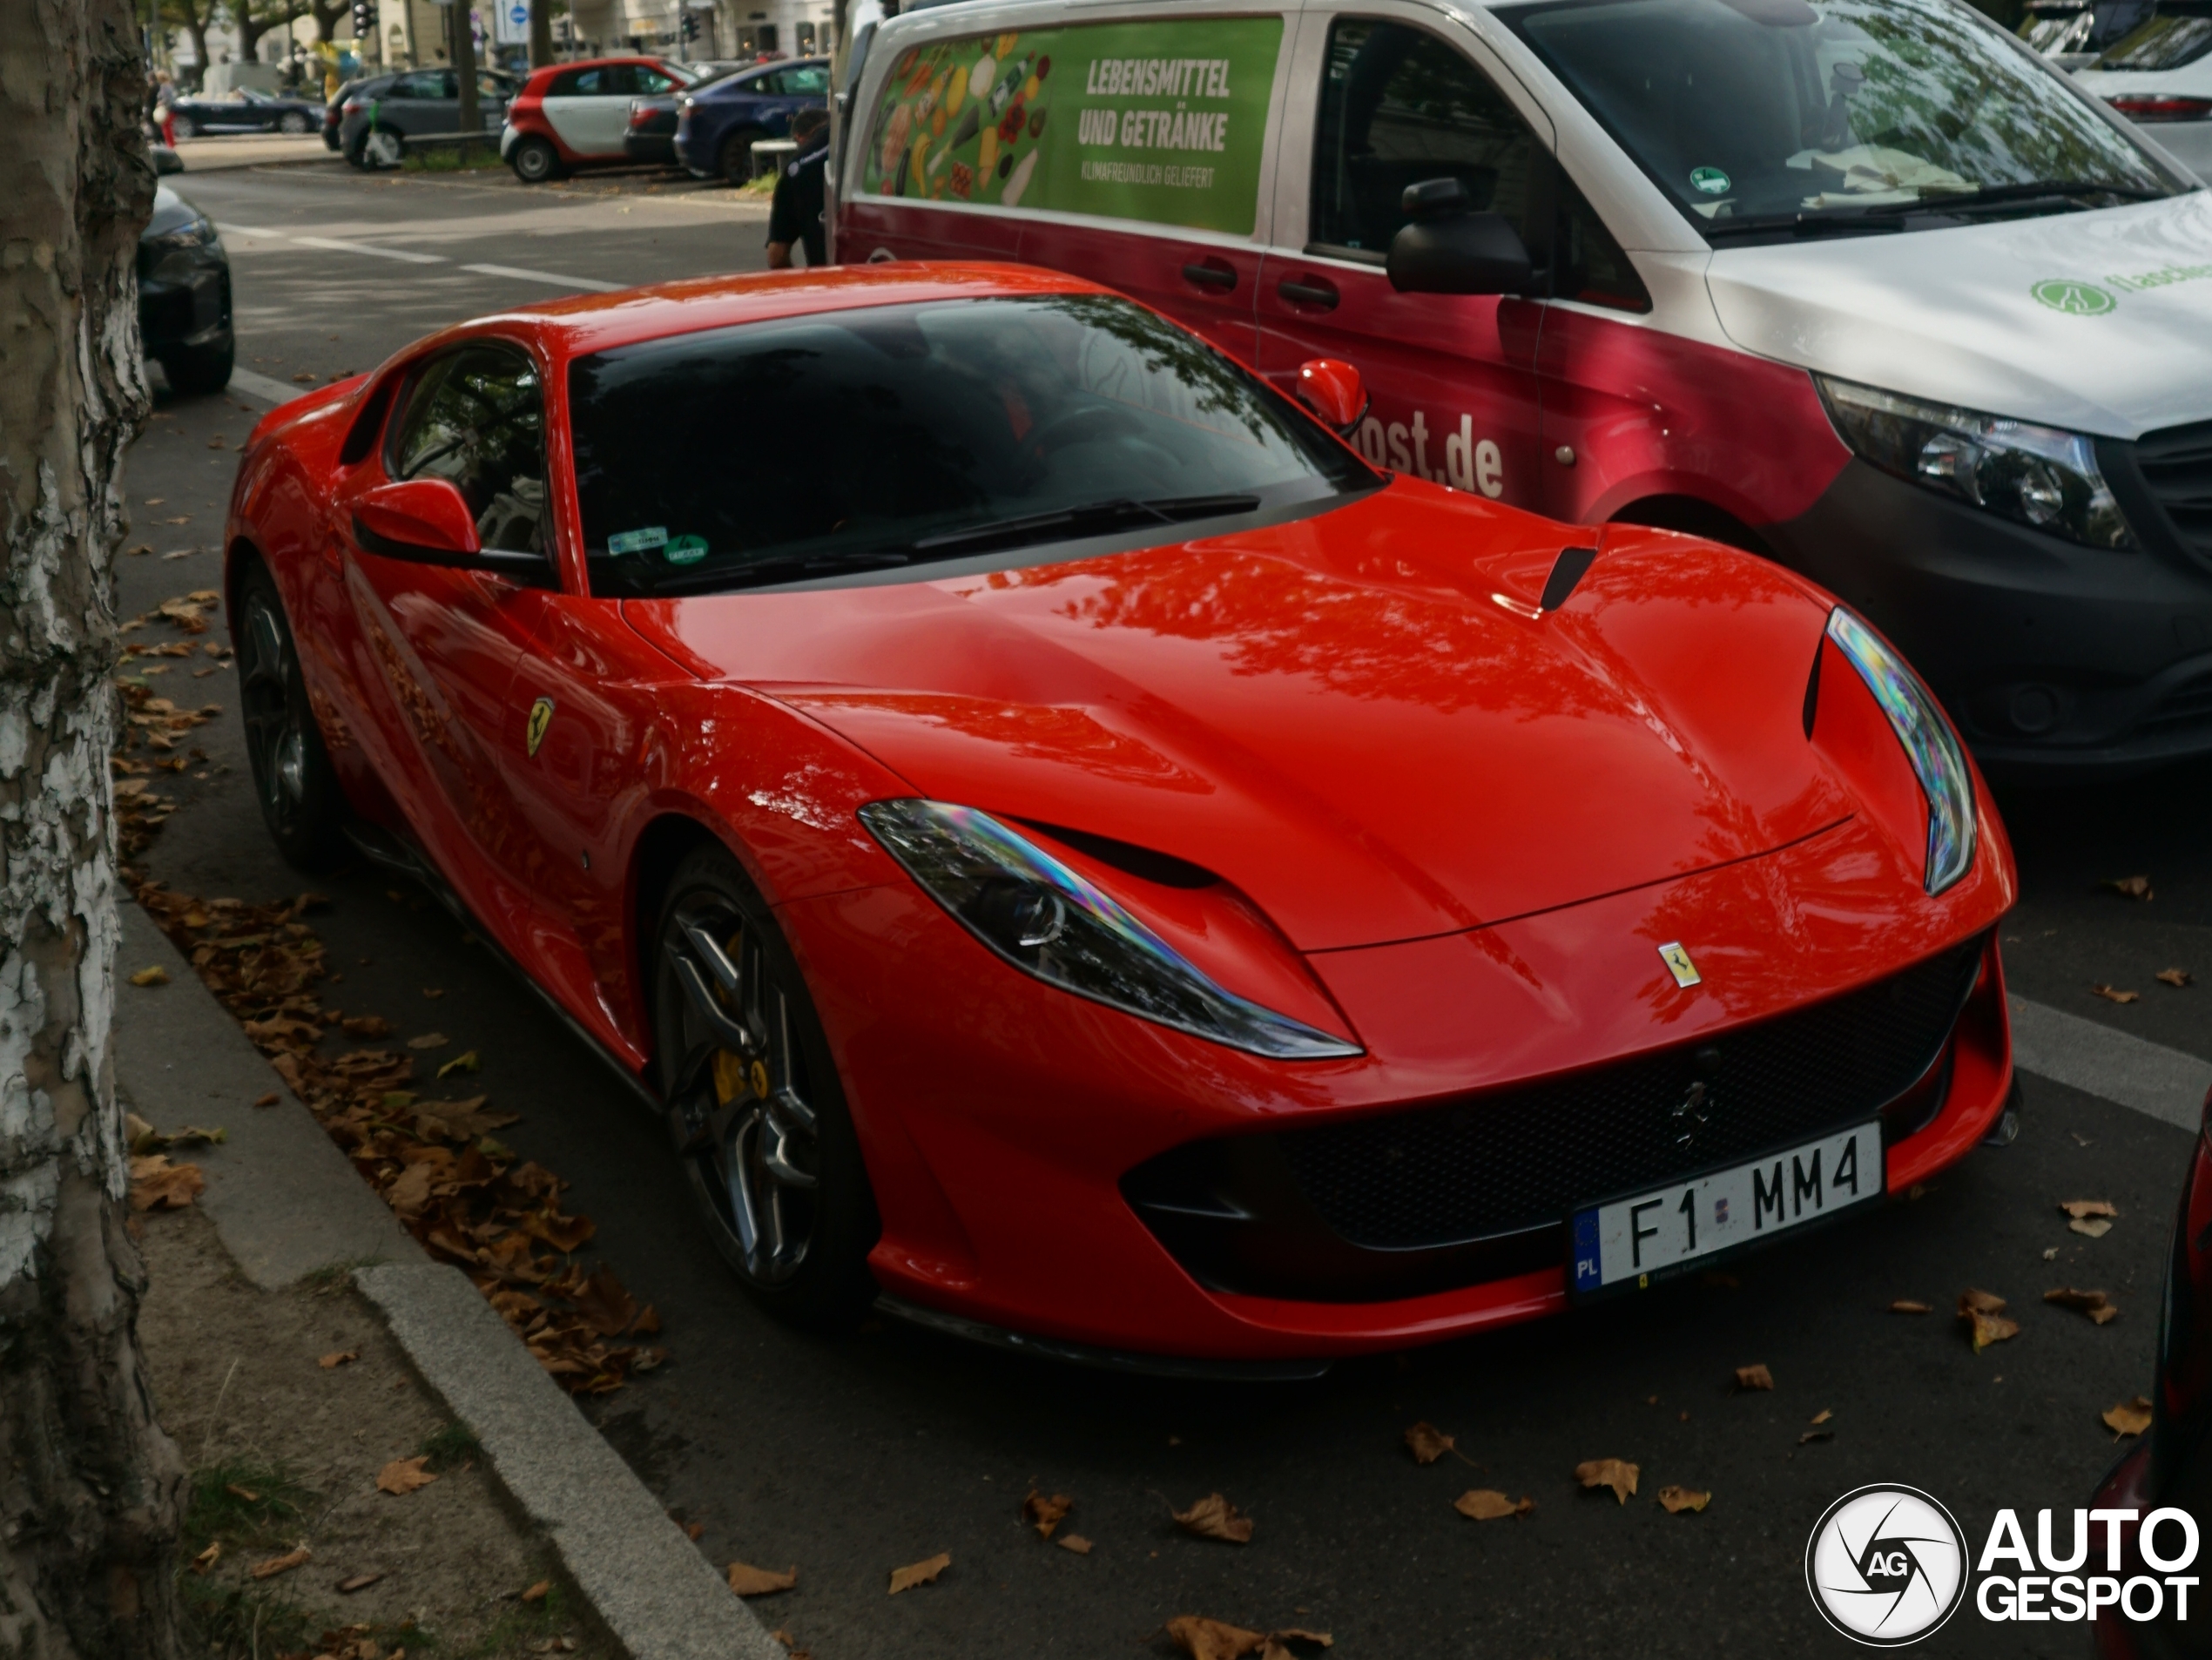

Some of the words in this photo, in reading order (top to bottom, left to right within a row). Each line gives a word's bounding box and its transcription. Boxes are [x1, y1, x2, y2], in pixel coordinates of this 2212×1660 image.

[1086, 58, 1231, 98] LEBENSMITTEL
[1078, 109, 1118, 147] UND
[1121, 101, 1229, 152] GETRÄNKE
[1081, 160, 1162, 185] KLIMAFREUNDLICH
[1164, 165, 1214, 188] GELIEFERT
[1630, 1189, 1696, 1268] F1
[1753, 1136, 1858, 1230] MM4
[1577, 1258, 1598, 1279] PL
